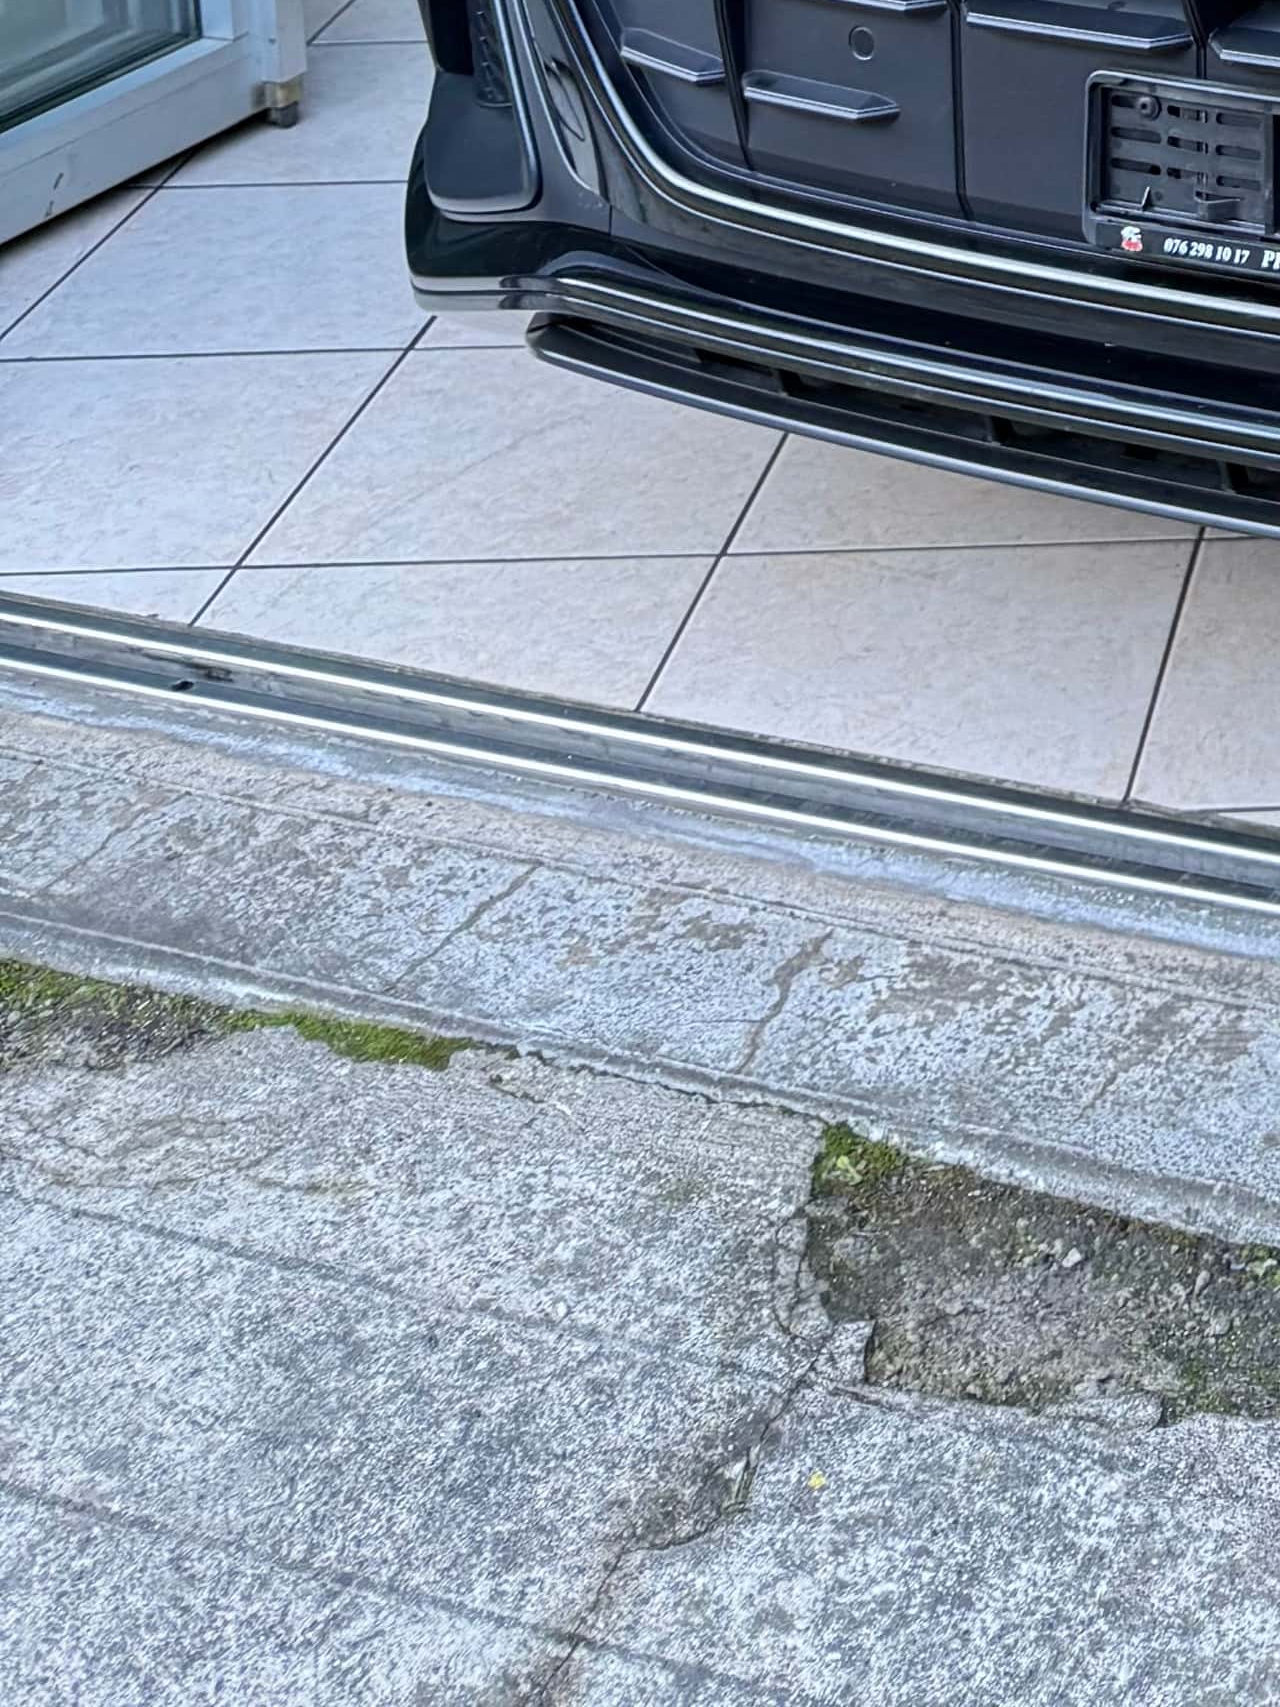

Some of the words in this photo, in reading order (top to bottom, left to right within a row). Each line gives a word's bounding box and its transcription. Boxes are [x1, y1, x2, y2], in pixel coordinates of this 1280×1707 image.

[1163, 237, 1189, 255] 076
[1189, 241, 1214, 259] 298
[1215, 245, 1232, 262] 10
[1233, 248, 1250, 265] 17
